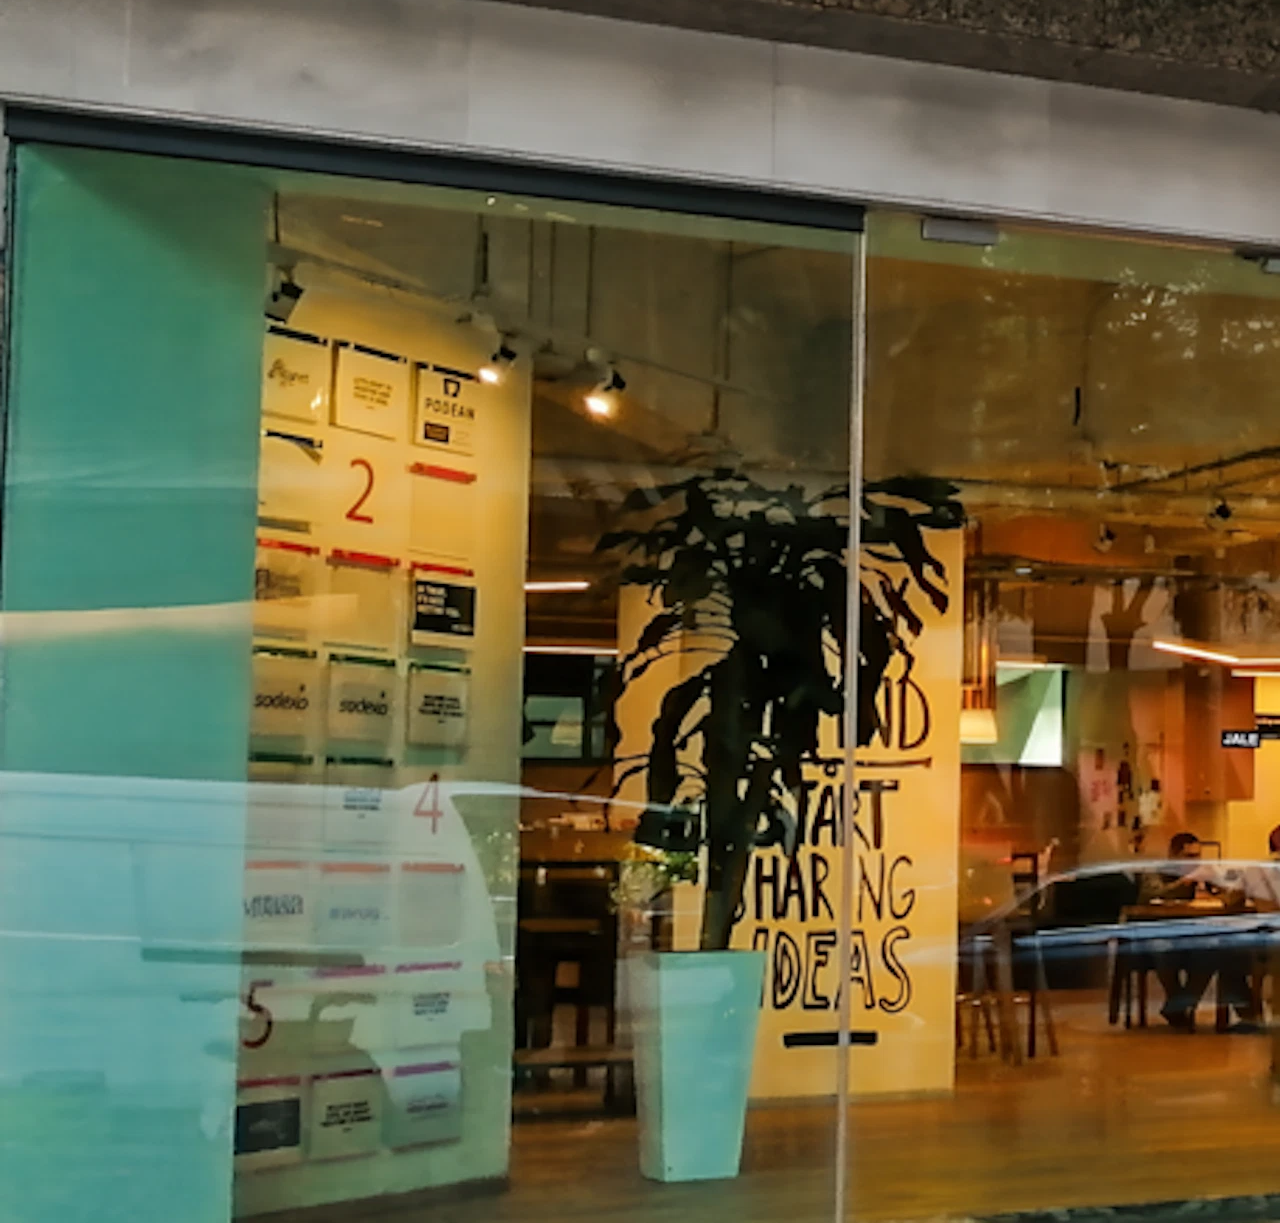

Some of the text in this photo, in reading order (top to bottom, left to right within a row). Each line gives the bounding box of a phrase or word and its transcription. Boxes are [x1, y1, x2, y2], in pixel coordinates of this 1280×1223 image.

[346, 458, 375, 525] 2
[413, 773, 444, 835] 4
[798, 778, 900, 849] TART
[243, 980, 274, 1048] 5
